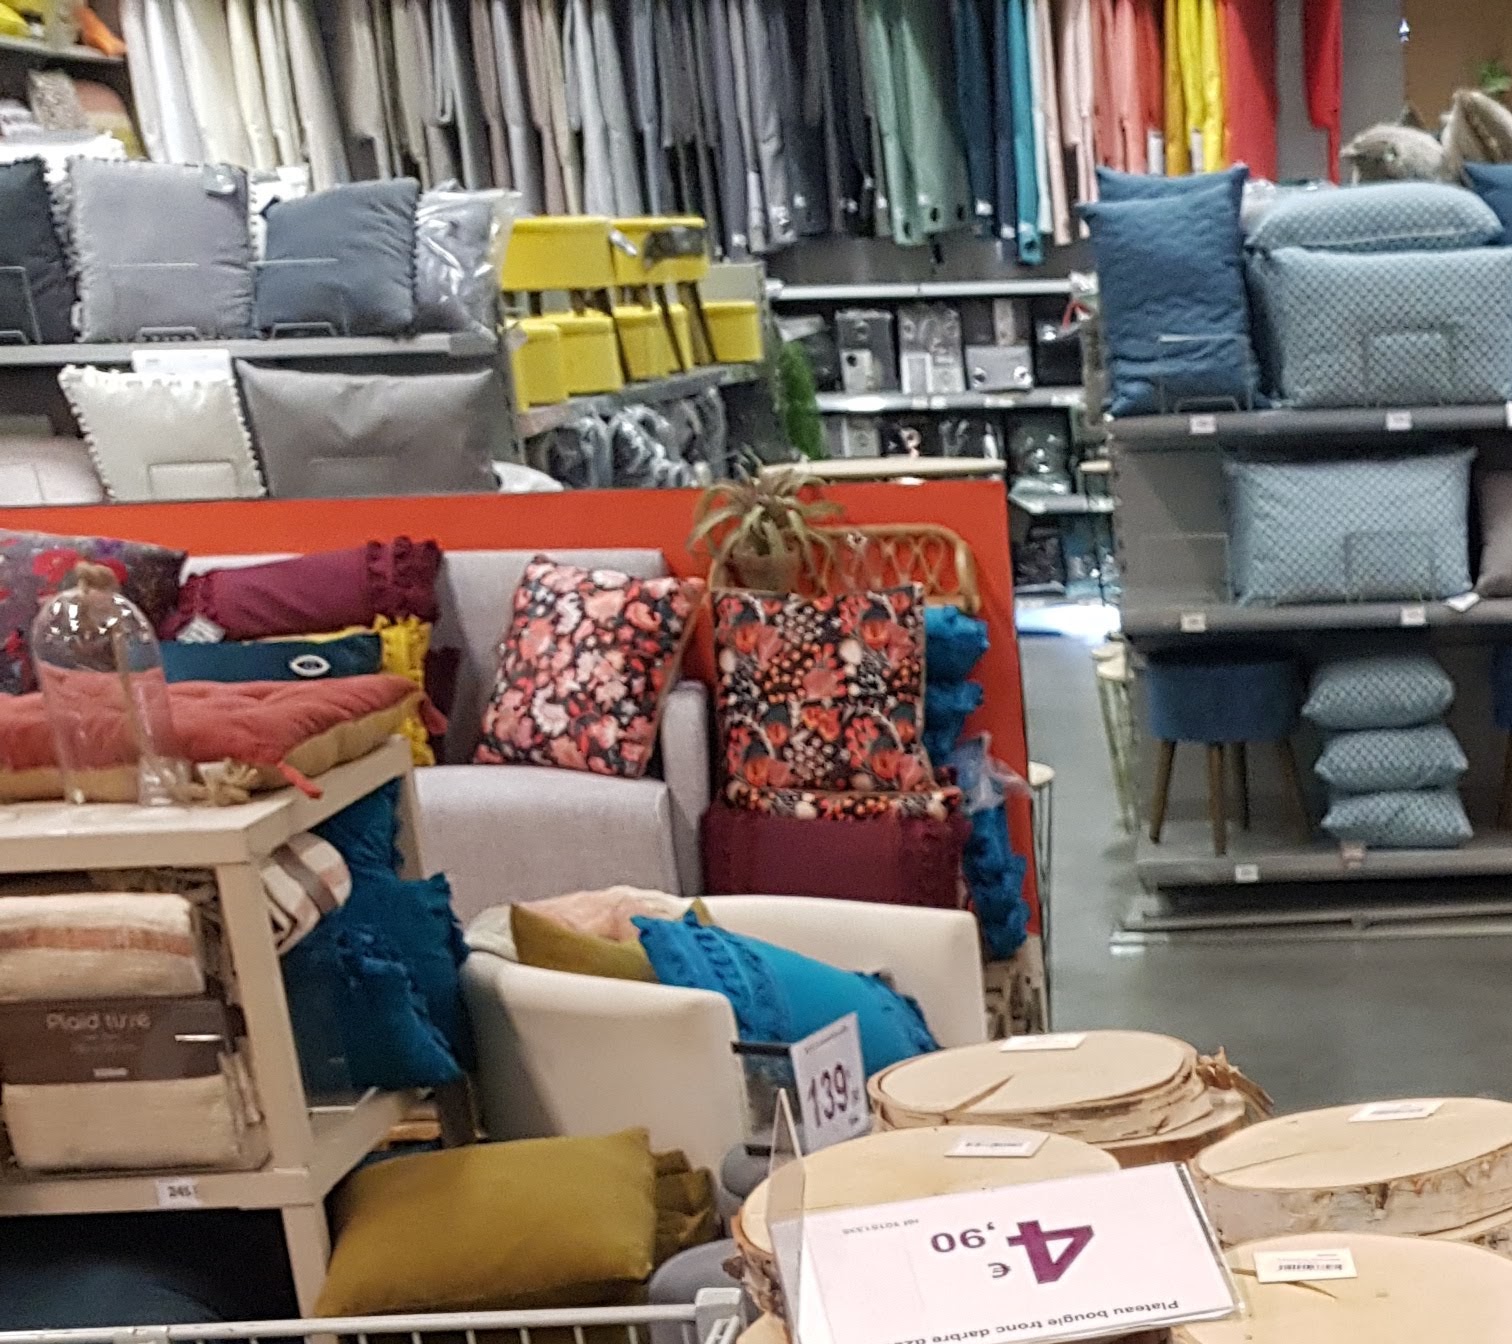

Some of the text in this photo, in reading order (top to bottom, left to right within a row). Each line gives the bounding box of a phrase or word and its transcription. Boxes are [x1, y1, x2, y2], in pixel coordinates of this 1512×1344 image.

[808, 1064, 848, 1127] 139
[1006, 1220, 1094, 1284] 4
[1113, 1300, 1180, 1316] Plateau
[1047, 1310, 1109, 1327] bougie
[932, 1327, 990, 1343] darbre
[995, 1320, 1043, 1334] tronc
